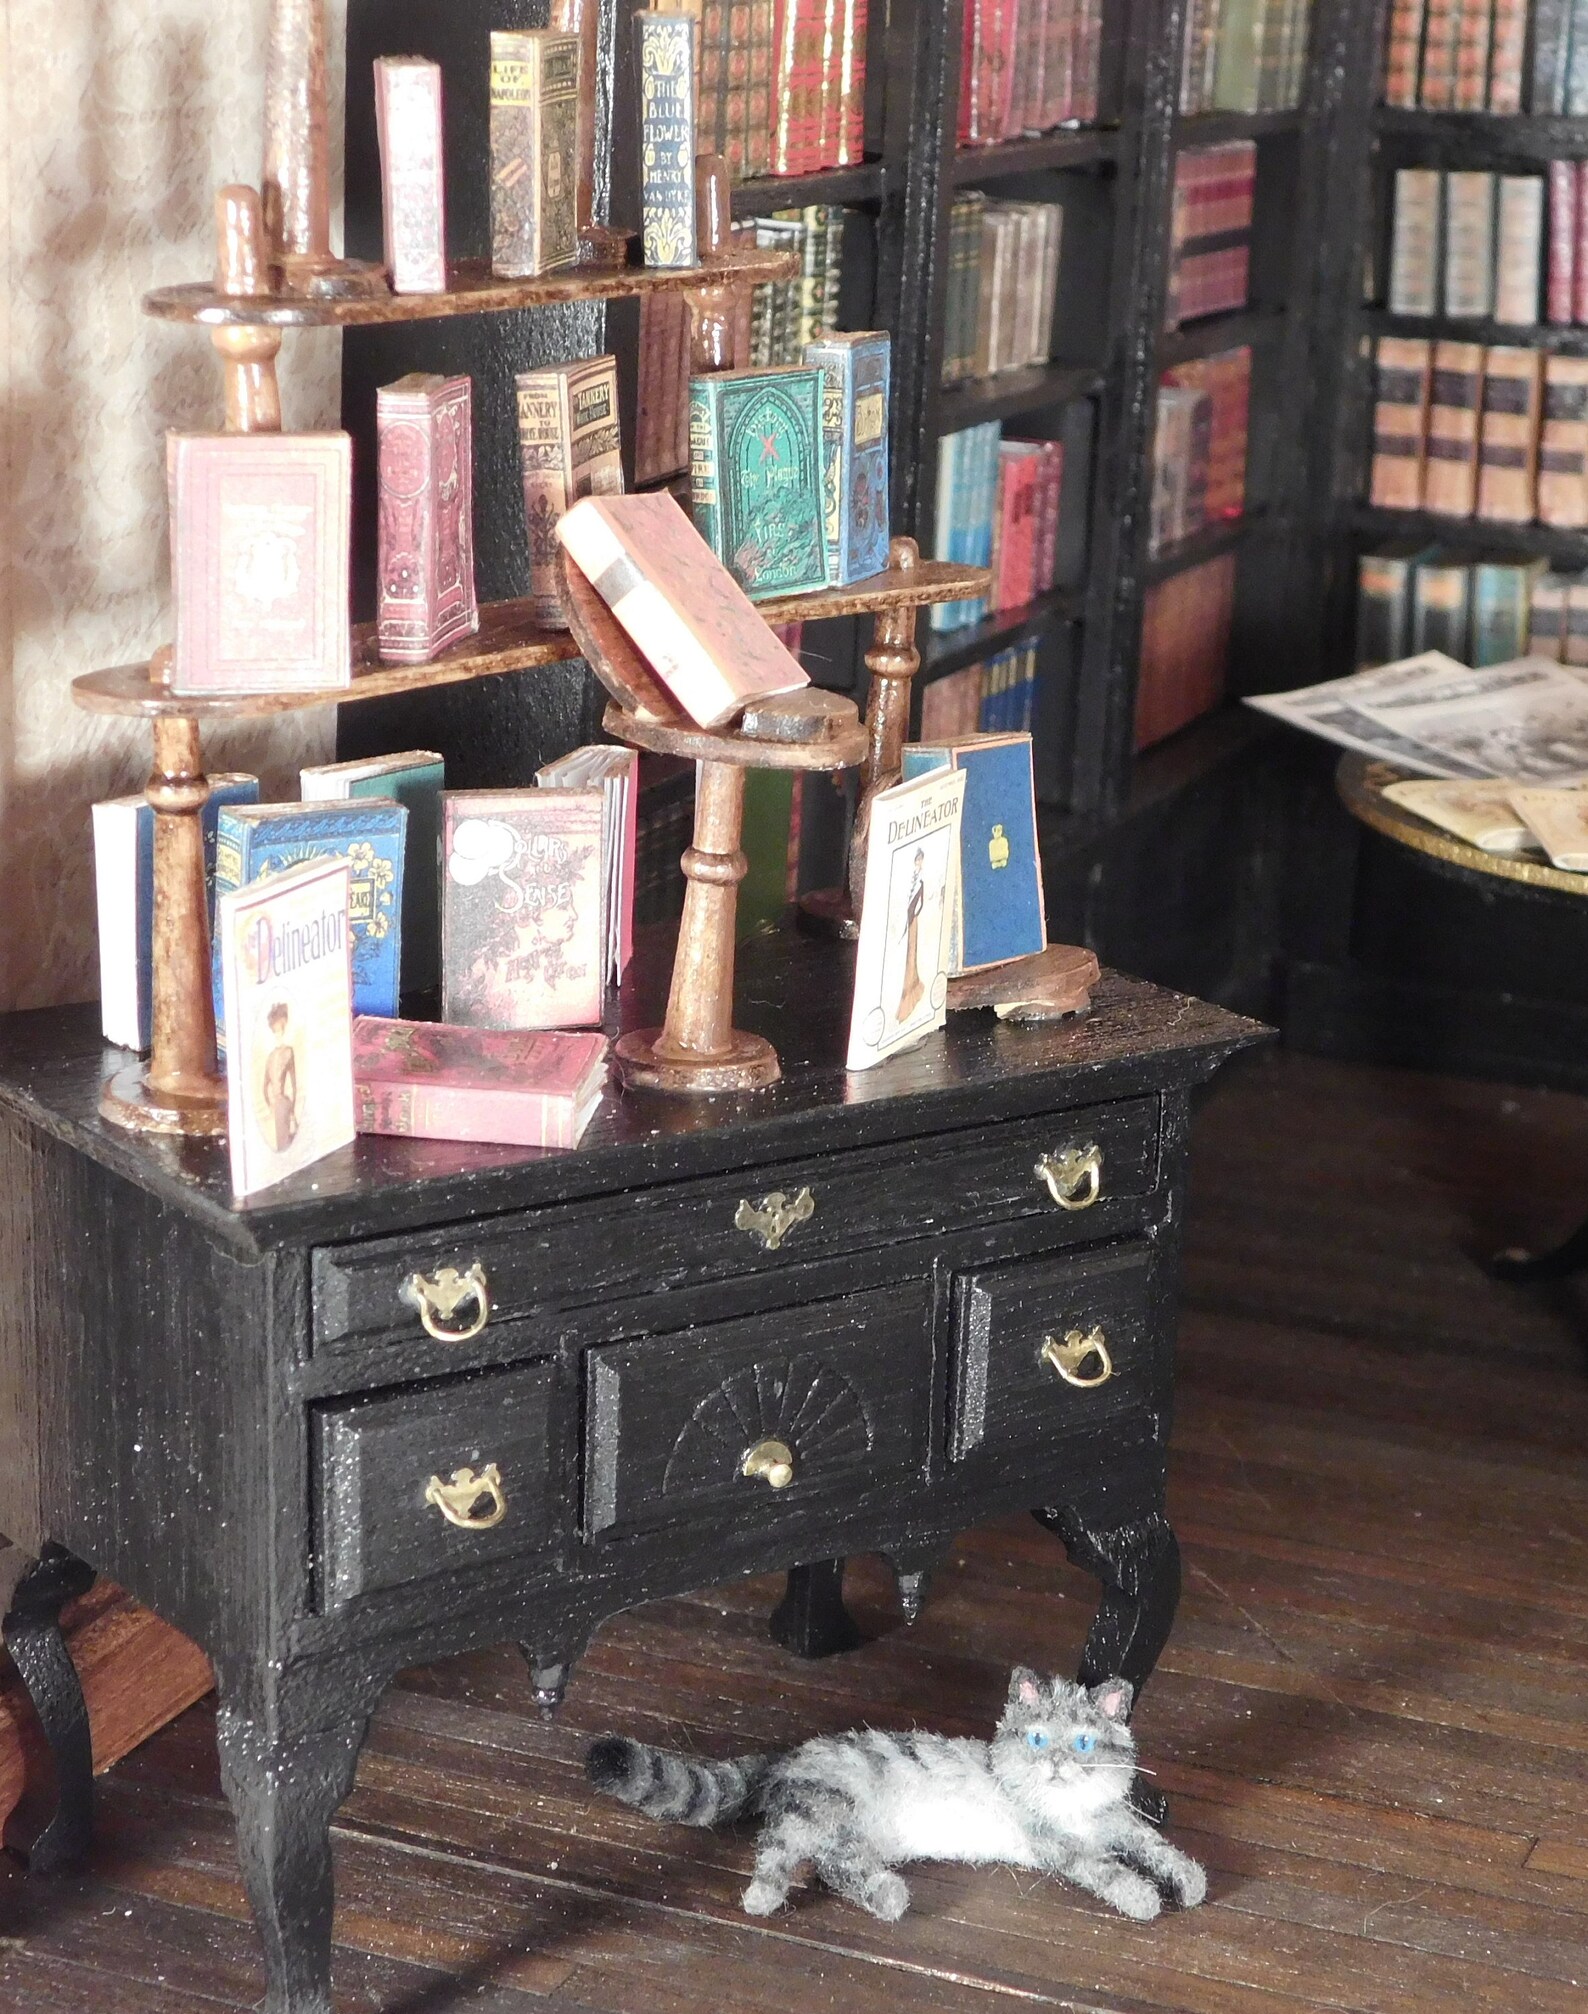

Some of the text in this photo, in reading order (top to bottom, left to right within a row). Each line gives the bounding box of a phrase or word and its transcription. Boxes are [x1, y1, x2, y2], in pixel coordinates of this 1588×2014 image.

[492, 64, 529, 75] LIFE
[649, 101, 685, 119] BLUE
[643, 123, 689, 142] FLOWER
[660, 151, 672, 165] BY
[649, 170, 682, 184] HENRY
[519, 401, 558, 420] ANNERY
[887, 797, 959, 845] DELINEATOR
[255, 908, 345, 985] Delineator
